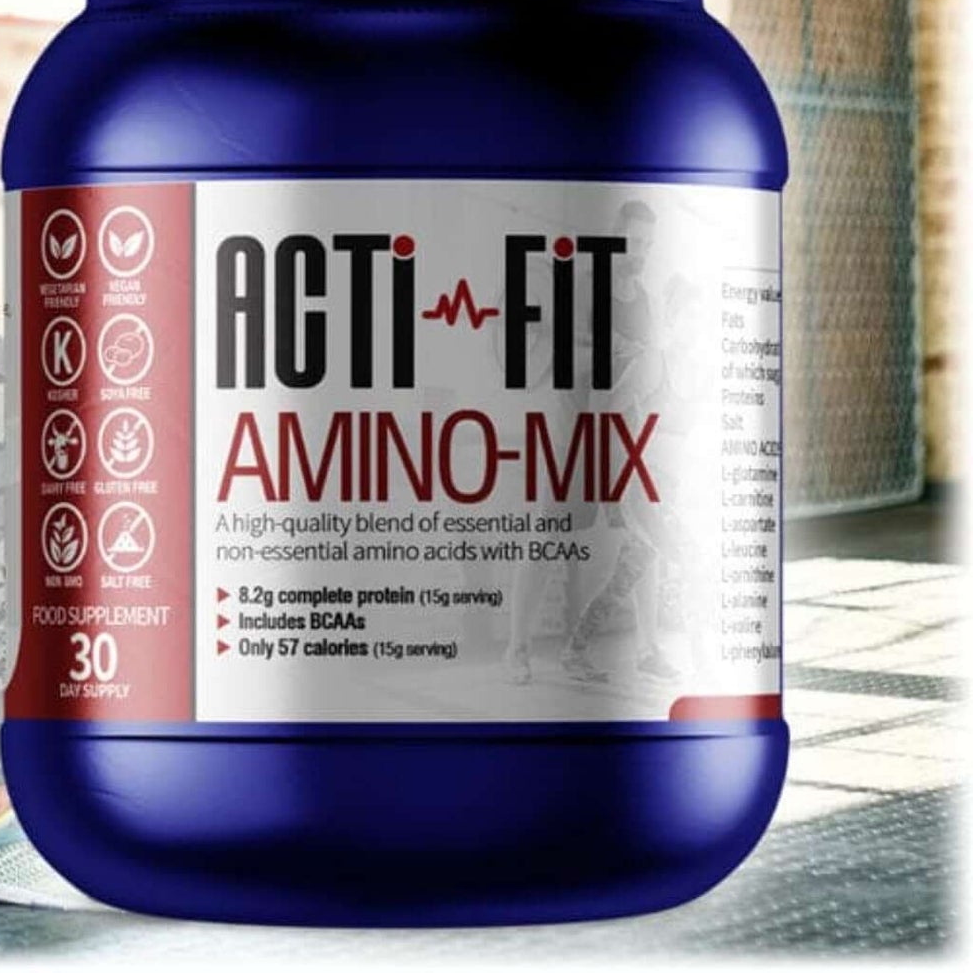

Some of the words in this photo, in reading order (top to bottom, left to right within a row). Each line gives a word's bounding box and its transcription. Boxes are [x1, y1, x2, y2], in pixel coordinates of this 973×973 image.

[109, 281, 141, 293] VEGAN
[44, 297, 79, 309] FRIENDLY
[103, 293, 146, 306] FRIENDLY
[101, 387, 126, 401] SOYA
[127, 387, 152, 400] FREE
[217, 410, 660, 504] AMINO-MIX
[65, 481, 86, 494] FREE
[94, 481, 131, 494] GLUTEN
[133, 481, 158, 494] FREE
[215, 513, 229, 532] A
[233, 512, 351, 538] high-quality
[355, 512, 414, 533] blend
[418, 511, 439, 532] of
[443, 512, 531, 533] essential
[535, 512, 572, 533] and
[216, 541, 348, 561] non-essential
[352, 541, 420, 561] amino
[423, 541, 477, 561] acids
[480, 541, 524, 561] with
[528, 542, 591, 561] BCAAs
[64, 575, 83, 587] GMO
[101, 575, 125, 588] SALT
[127, 575, 152, 588] FREE
[238, 586, 274, 607] 8.2g
[277, 587, 353, 608] complete
[357, 586, 415, 607] protein
[419, 588, 450, 606] (15g
[453, 589, 503, 606] serving)
[32, 606, 66, 625] FOOD
[68, 606, 170, 625] SUPPLEMENT
[238, 612, 306, 630] Includes
[310, 612, 366, 630] BCAAs
[238, 638, 273, 659] Only
[277, 638, 299, 656] 57
[303, 638, 369, 656] calories
[373, 641, 403, 658] (15g
[406, 641, 457, 658] serving)
[69, 632, 118, 681] 30
[60, 684, 81, 698] DAY
[83, 684, 130, 698] SUPPLY
